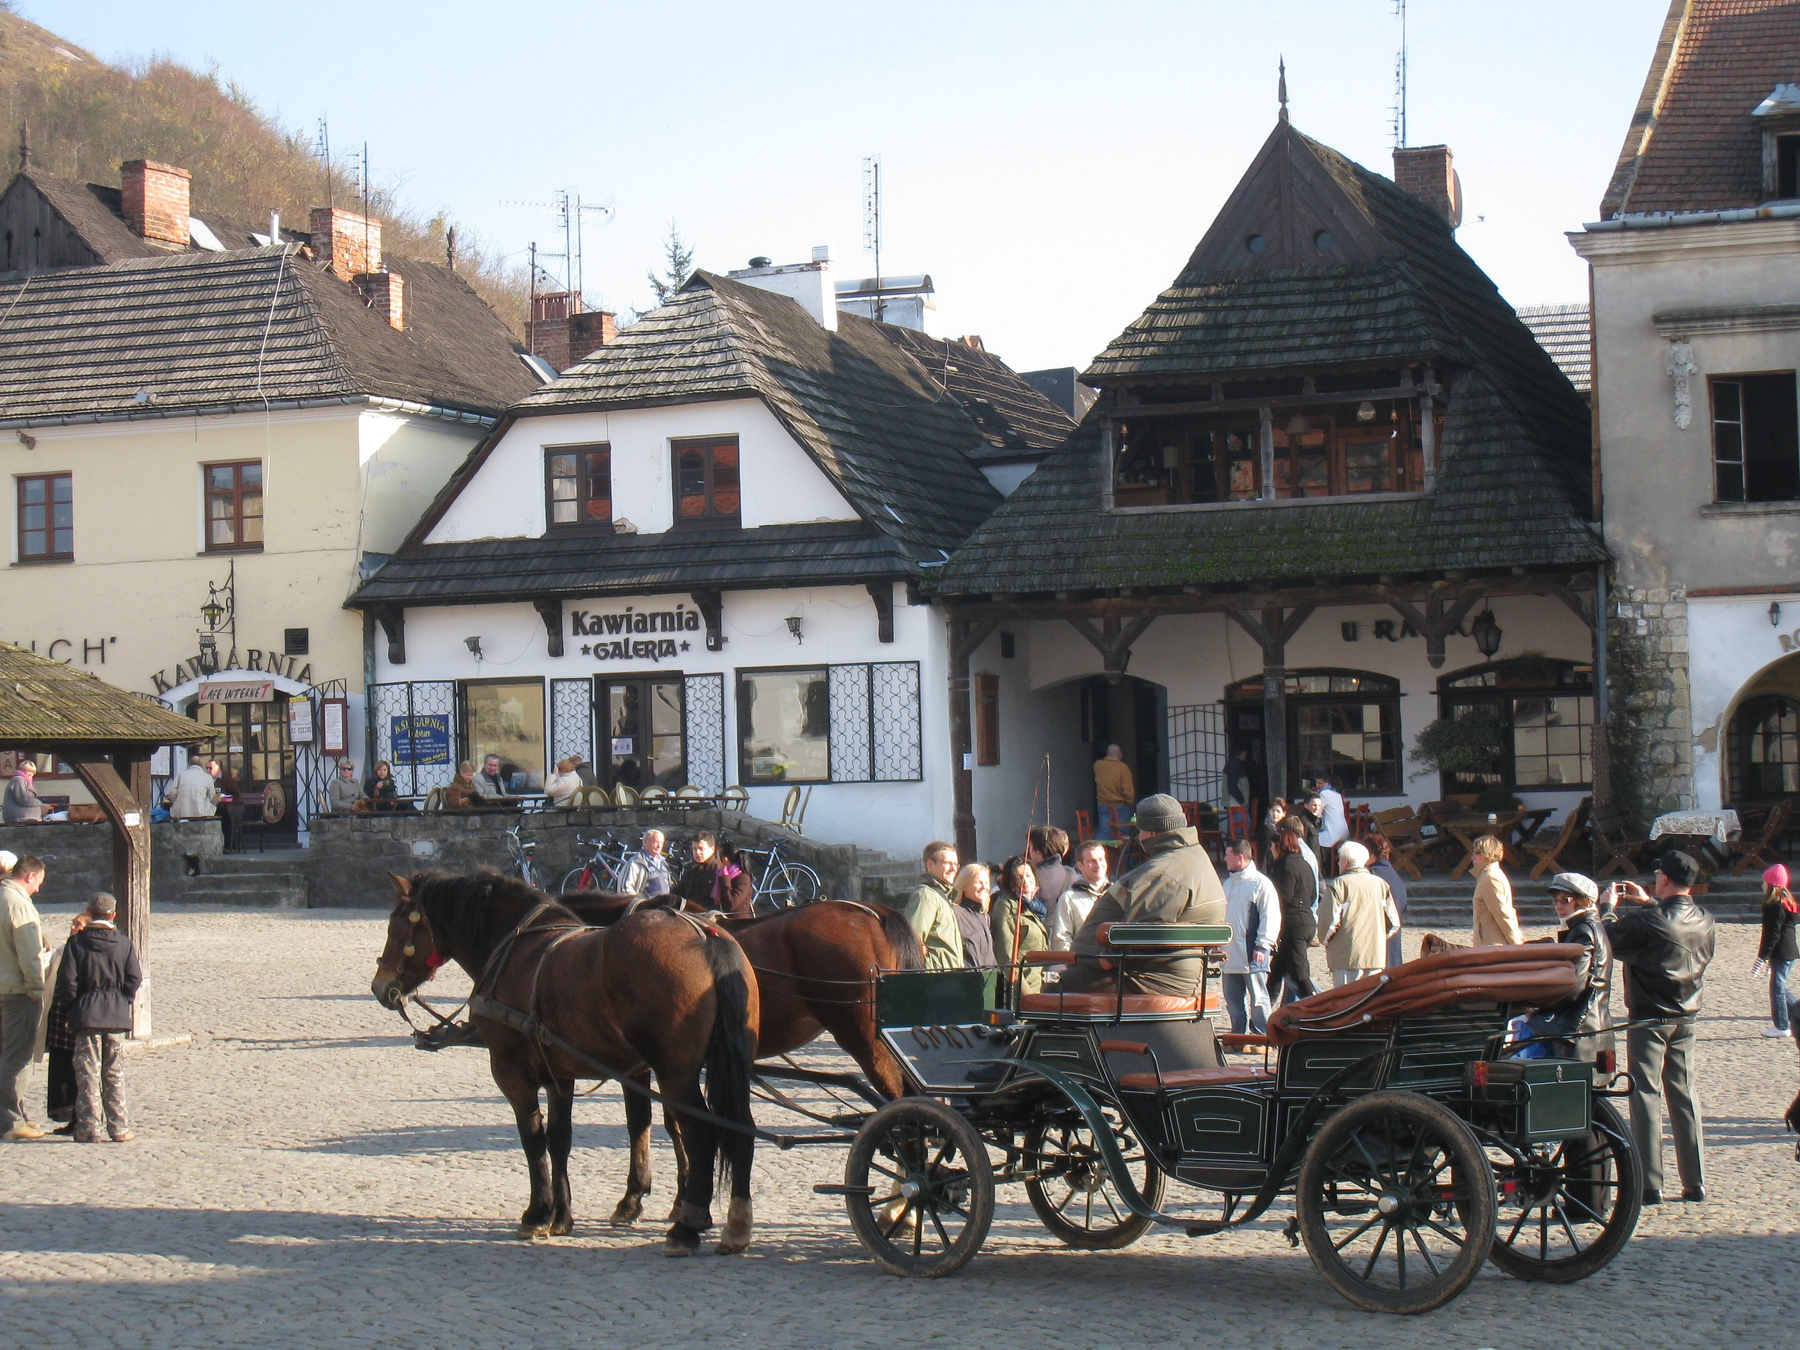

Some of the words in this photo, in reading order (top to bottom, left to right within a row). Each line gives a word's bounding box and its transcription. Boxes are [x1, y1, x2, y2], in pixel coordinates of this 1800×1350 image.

[571, 604, 700, 636] Kawiarnia
[593, 637, 678, 663] GALERIA
[200, 685, 222, 701] CAFE
[224, 683, 272, 700] INTERNET
[393, 716, 446, 735] KSIGARNIA
